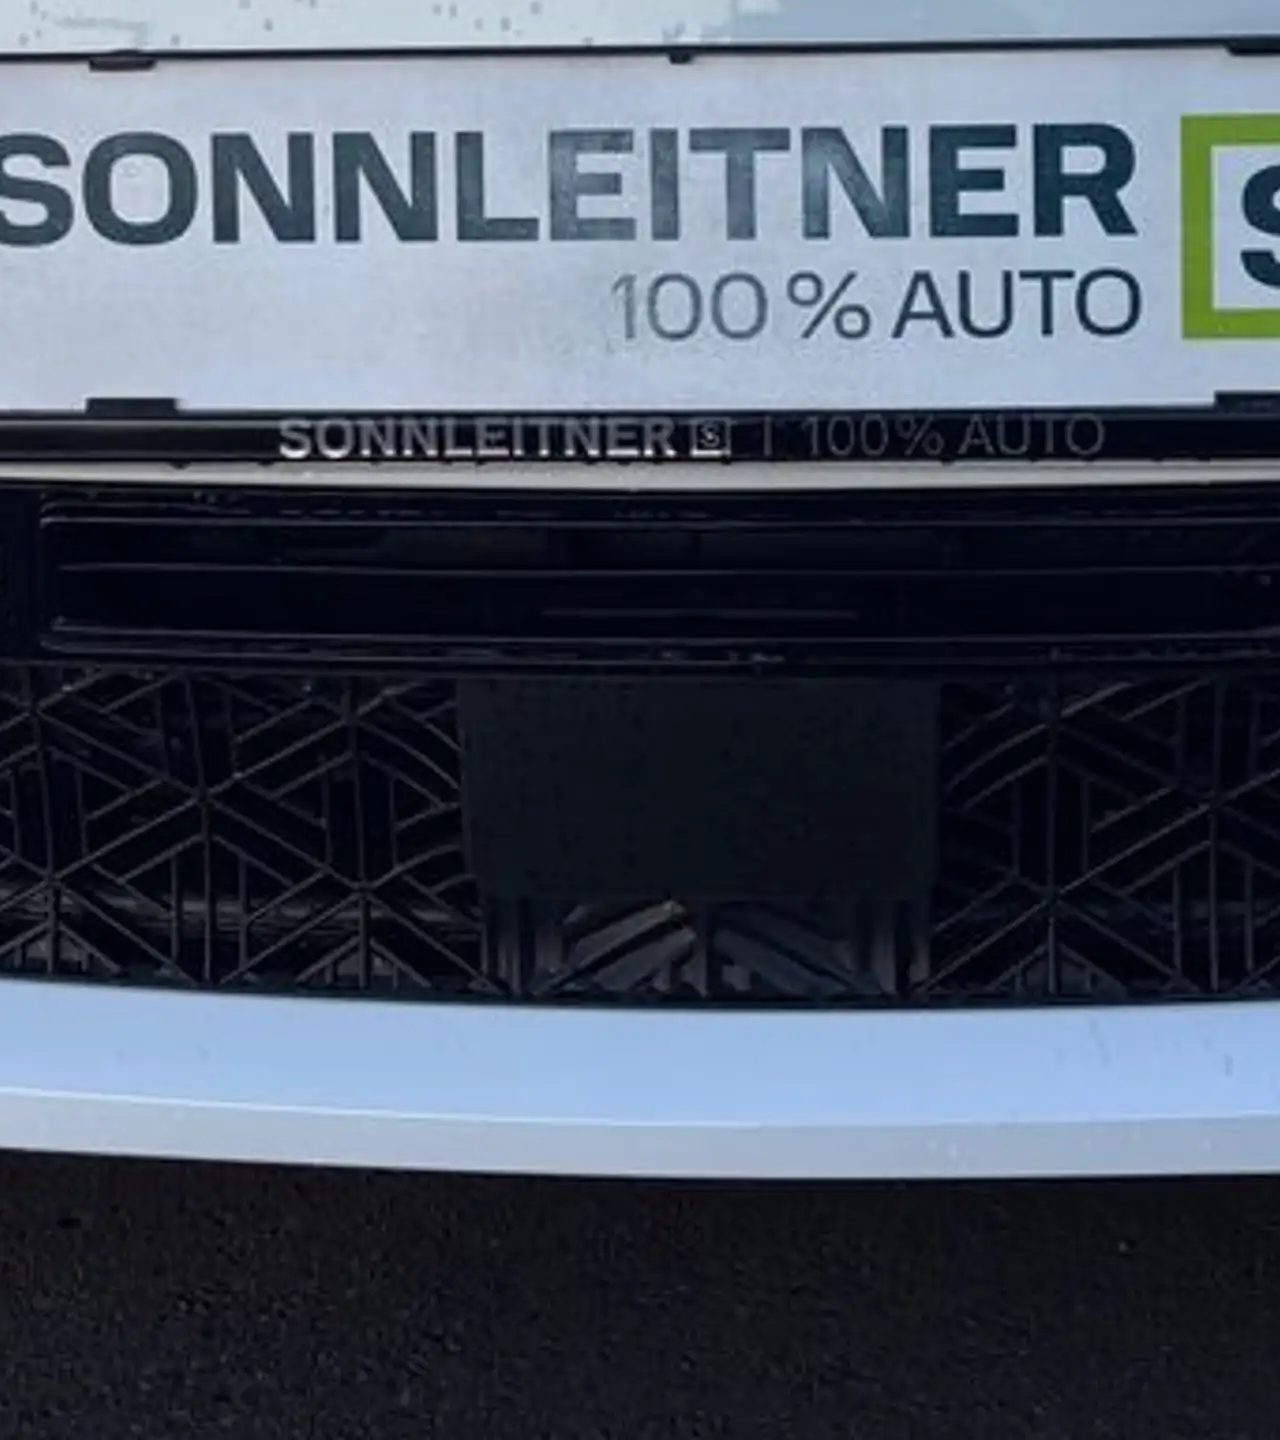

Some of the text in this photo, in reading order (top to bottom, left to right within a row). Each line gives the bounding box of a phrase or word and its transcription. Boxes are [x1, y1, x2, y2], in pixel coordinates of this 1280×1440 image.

[891, 267, 1143, 339] AUTO
[278, 416, 676, 460] SONNLEITNER
[959, 412, 1106, 457] AUTO
